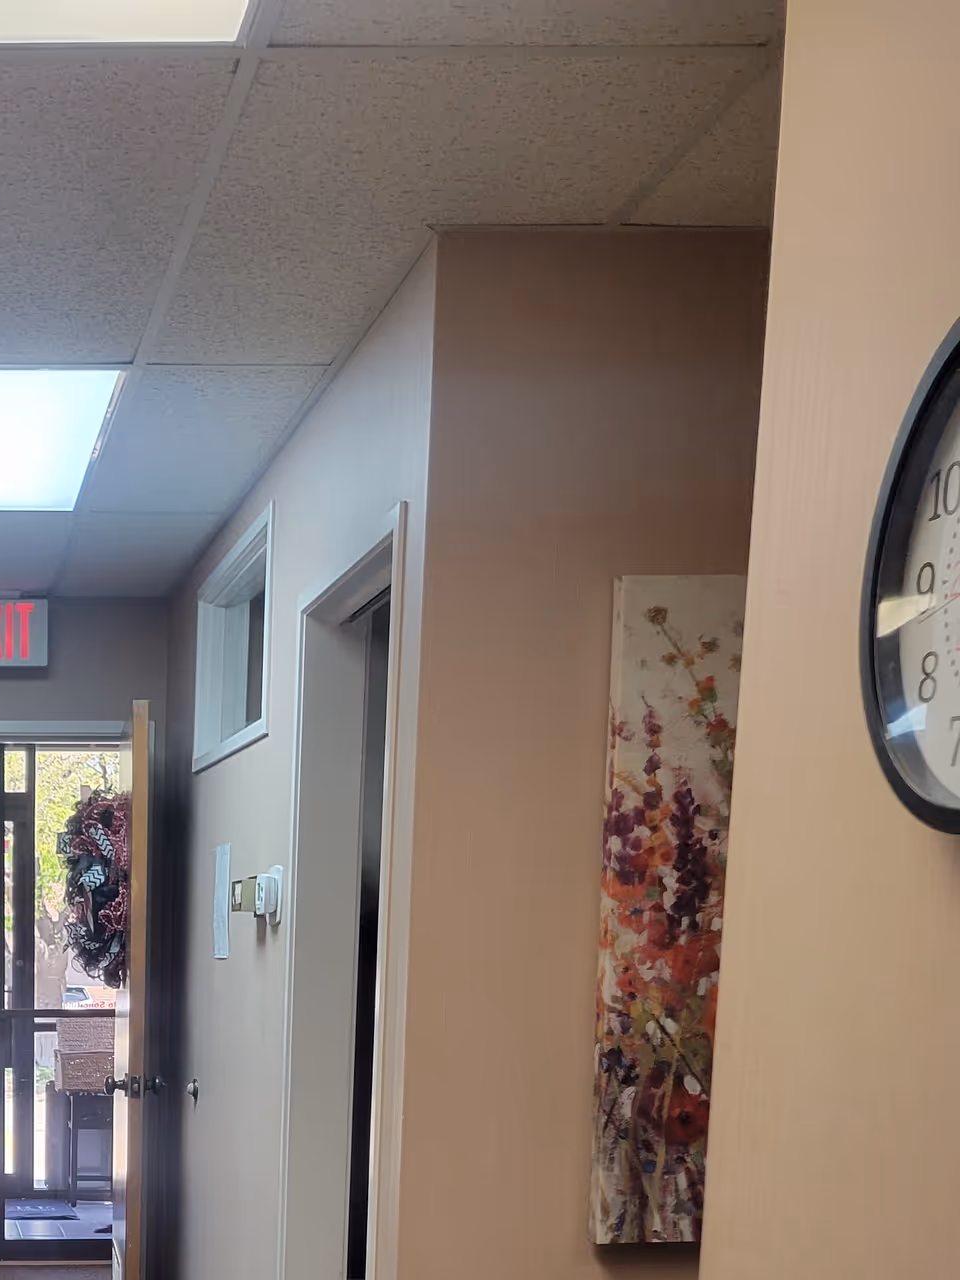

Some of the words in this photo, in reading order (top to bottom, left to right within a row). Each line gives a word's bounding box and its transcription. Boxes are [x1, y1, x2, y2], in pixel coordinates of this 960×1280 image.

[928, 461, 960, 521] 10
[917, 562, 935, 616] 9
[919, 651, 938, 703] 8
